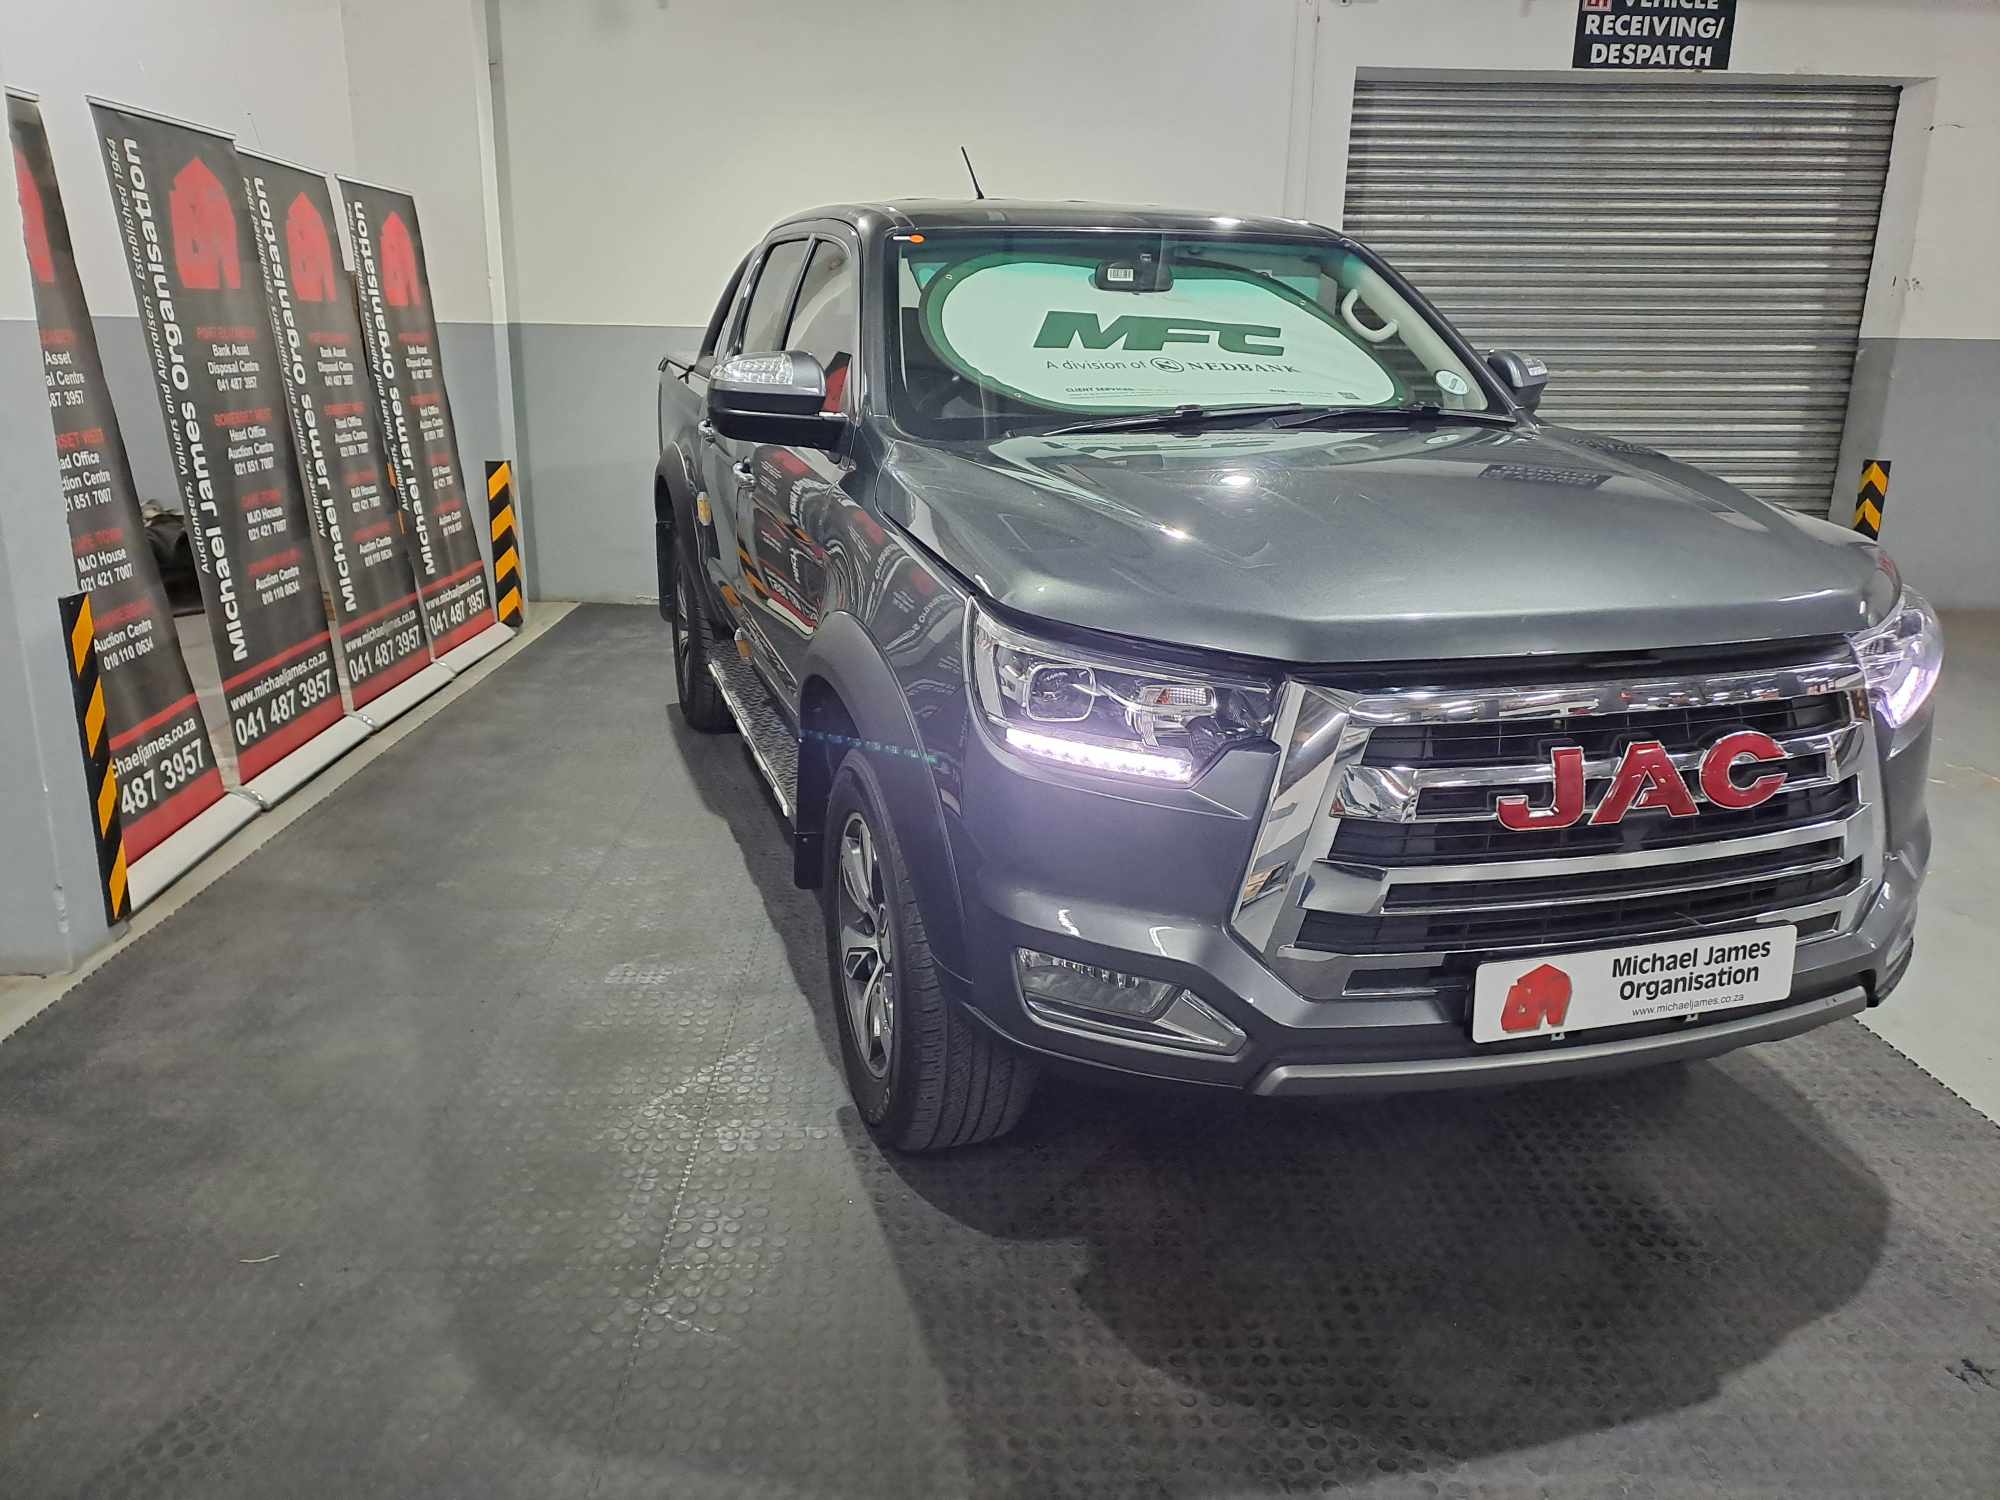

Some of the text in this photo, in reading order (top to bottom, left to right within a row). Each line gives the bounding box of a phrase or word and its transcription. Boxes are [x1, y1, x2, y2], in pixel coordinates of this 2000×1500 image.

[1584, 14, 1726, 39] RECEIVING/
[1590, 43, 1713, 67] DESPATCH
[115, 183, 146, 281] Established
[253, 177, 306, 385] Organisation
[353, 201, 395, 380] Organisation
[142, 295, 168, 381] Appraisers
[1033, 310, 1285, 356] MFC
[44, 351, 72, 365] Asset
[56, 370, 85, 386] Centre
[1045, 359, 1302, 374] A division of NEDBANK
[64, 390, 84, 406] 3957
[123, 137, 249, 662] Michael James Organisation
[160, 383, 175, 414] and
[170, 418, 189, 475] Valuers
[301, 393, 331, 491] James
[389, 387, 414, 470] James
[72, 450, 100, 467] Office
[83, 469, 111, 486] Centre
[74, 492, 92, 509] 851
[92, 487, 112, 505] 7007
[405, 477, 436, 575] Michael
[77, 548, 127, 573] MJO House
[321, 498, 358, 613] Michael
[80, 563, 134, 592] 021 421 7007
[429, 588, 486, 636] 041 487 3957
[93, 618, 153, 655] Auction Centre
[348, 624, 421, 682] 041 487 3957
[103, 651, 119, 671] 010
[119, 645, 135, 664] 110
[230, 650, 328, 711] www.michaeljames.co.za
[235, 668, 332, 746] 041 487 3957
[120, 738, 205, 816] 487 3957
[1496, 730, 1788, 831] JAC
[1612, 940, 1771, 978] Michael James
[1619, 965, 1759, 1001] Organisation
[1632, 993, 1745, 1017] www.michaeljames.co.za
